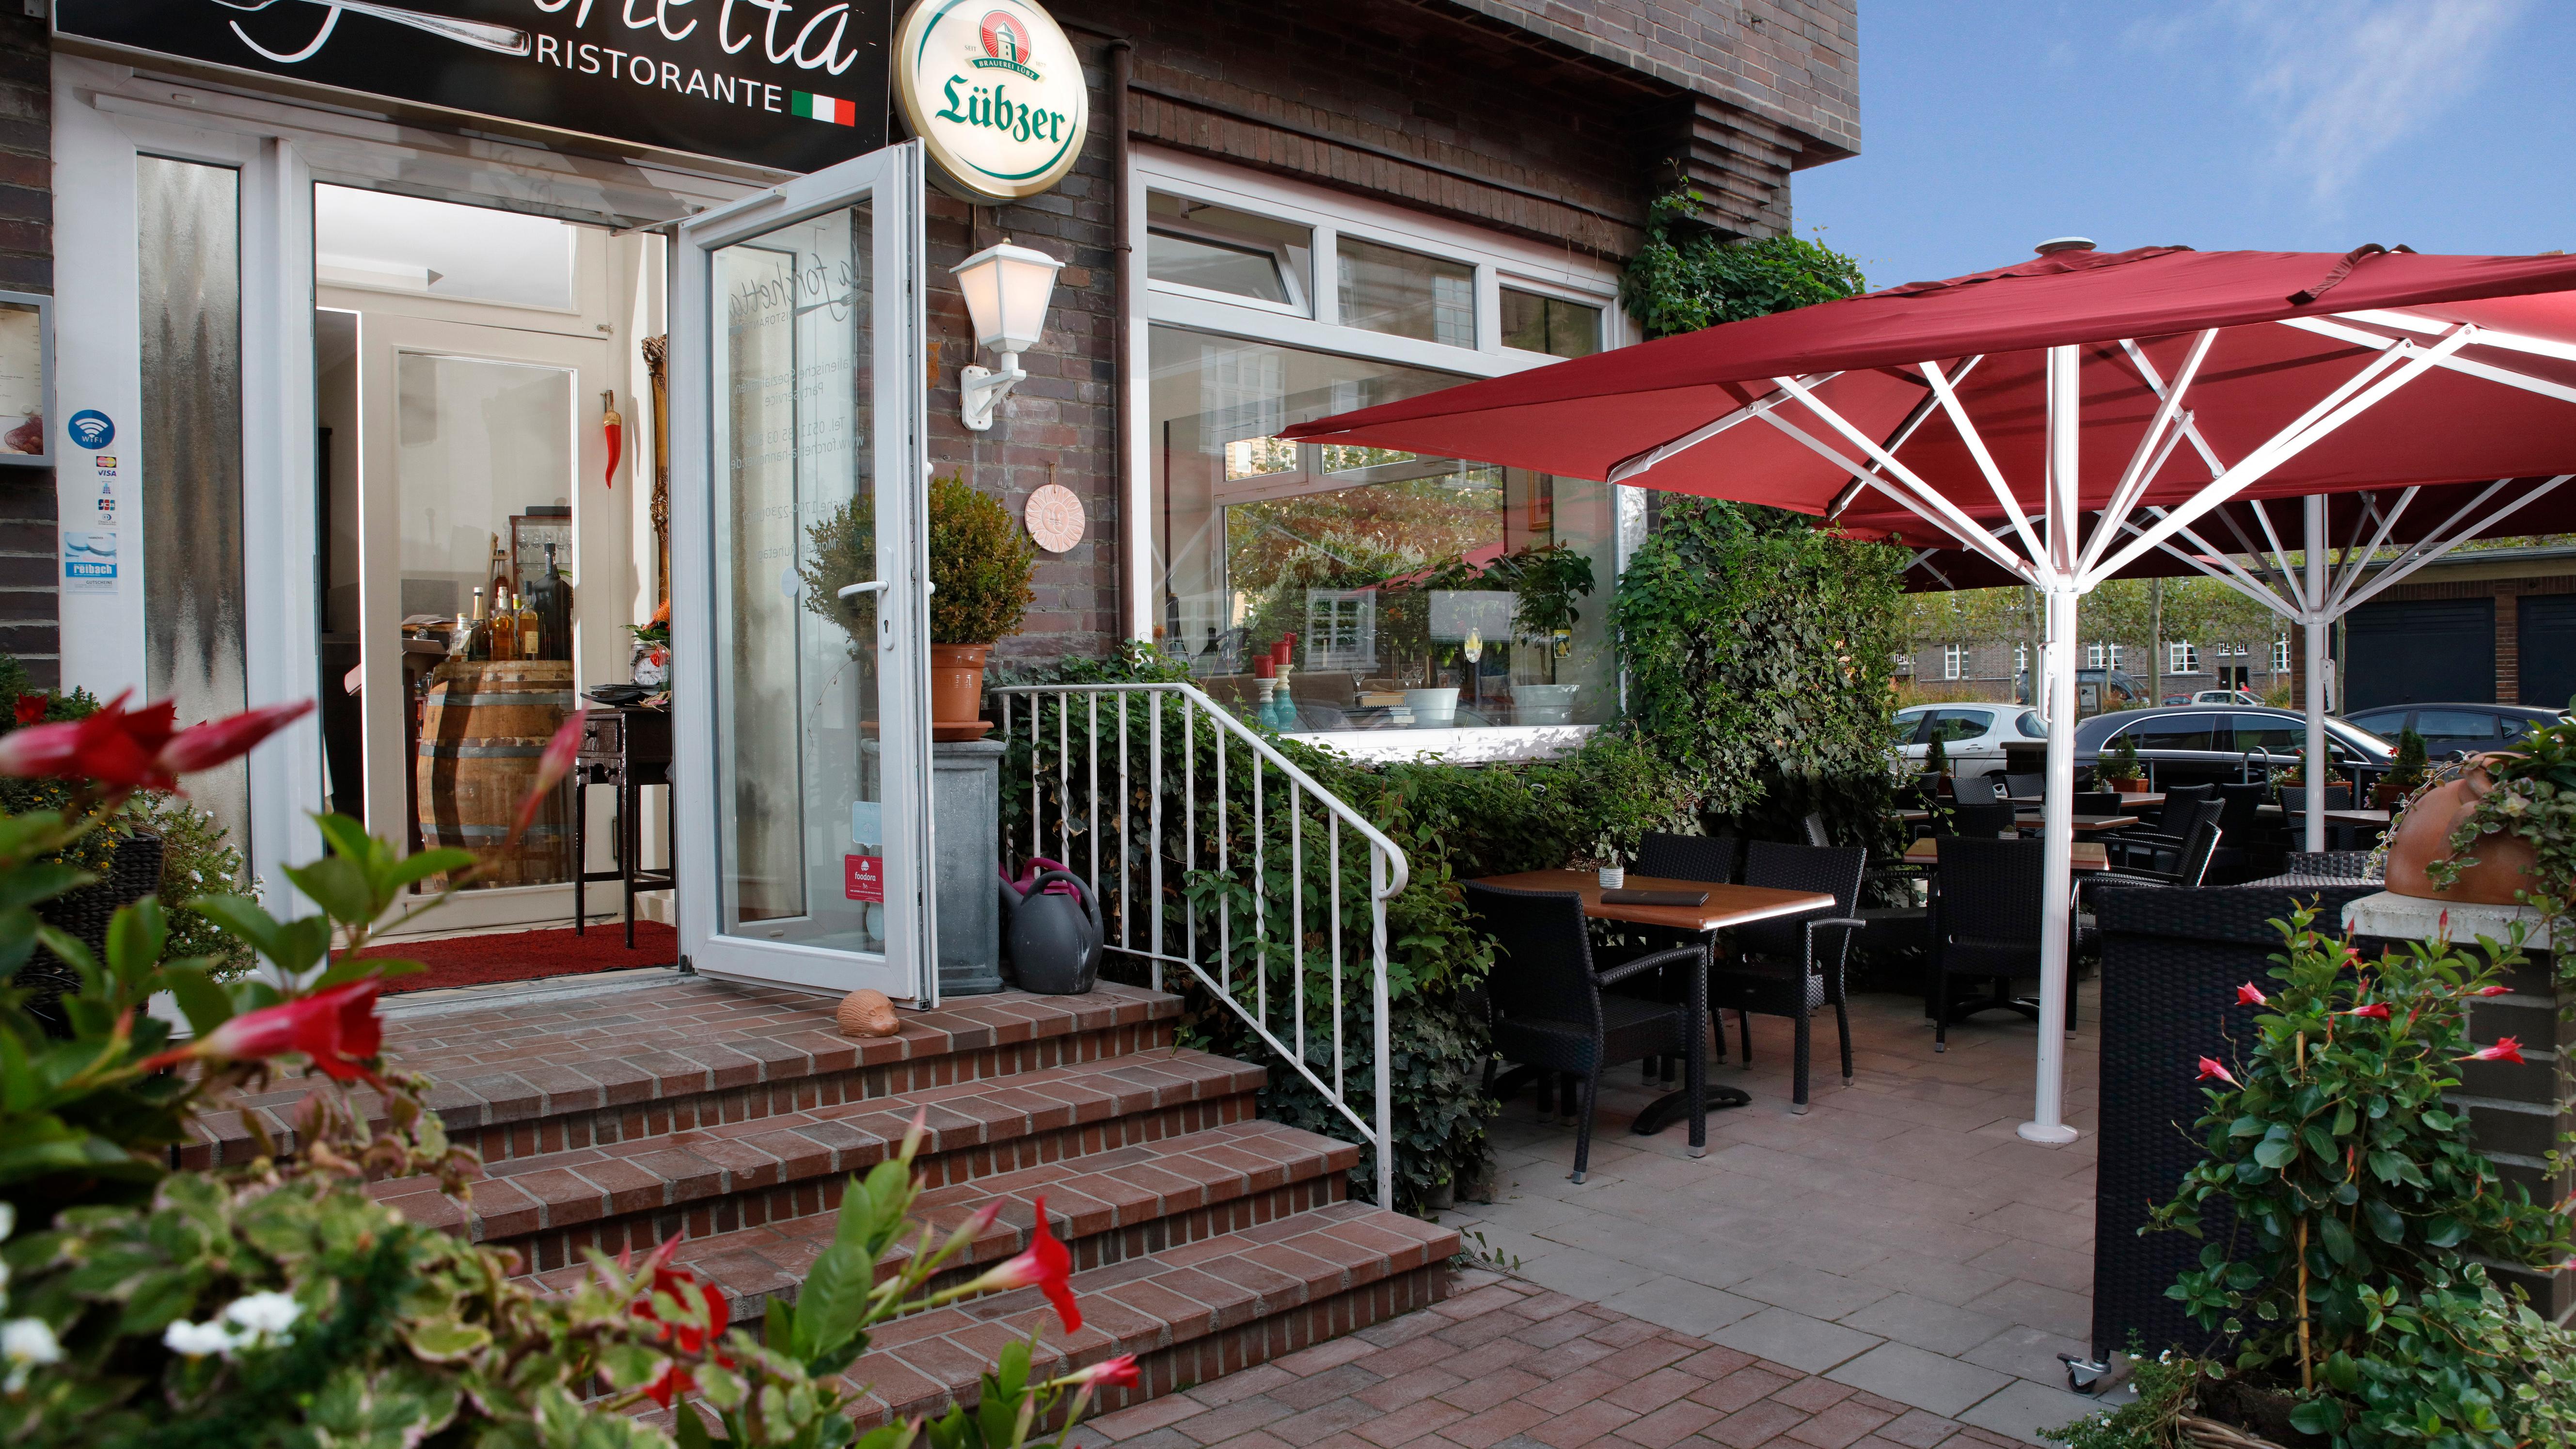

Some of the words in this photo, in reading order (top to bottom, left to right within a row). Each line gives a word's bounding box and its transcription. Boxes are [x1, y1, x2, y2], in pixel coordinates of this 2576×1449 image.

[537, 33, 783, 113] RISTORANTE
[978, 60, 1014, 70] BRAUEREI
[1016, 64, 1035, 80] LÜBZ
[935, 74, 1066, 144] Lübzer
[81, 436, 103, 444] WiFi
[74, 564, 112, 574] reibach
[855, 871, 876, 881] foodora
